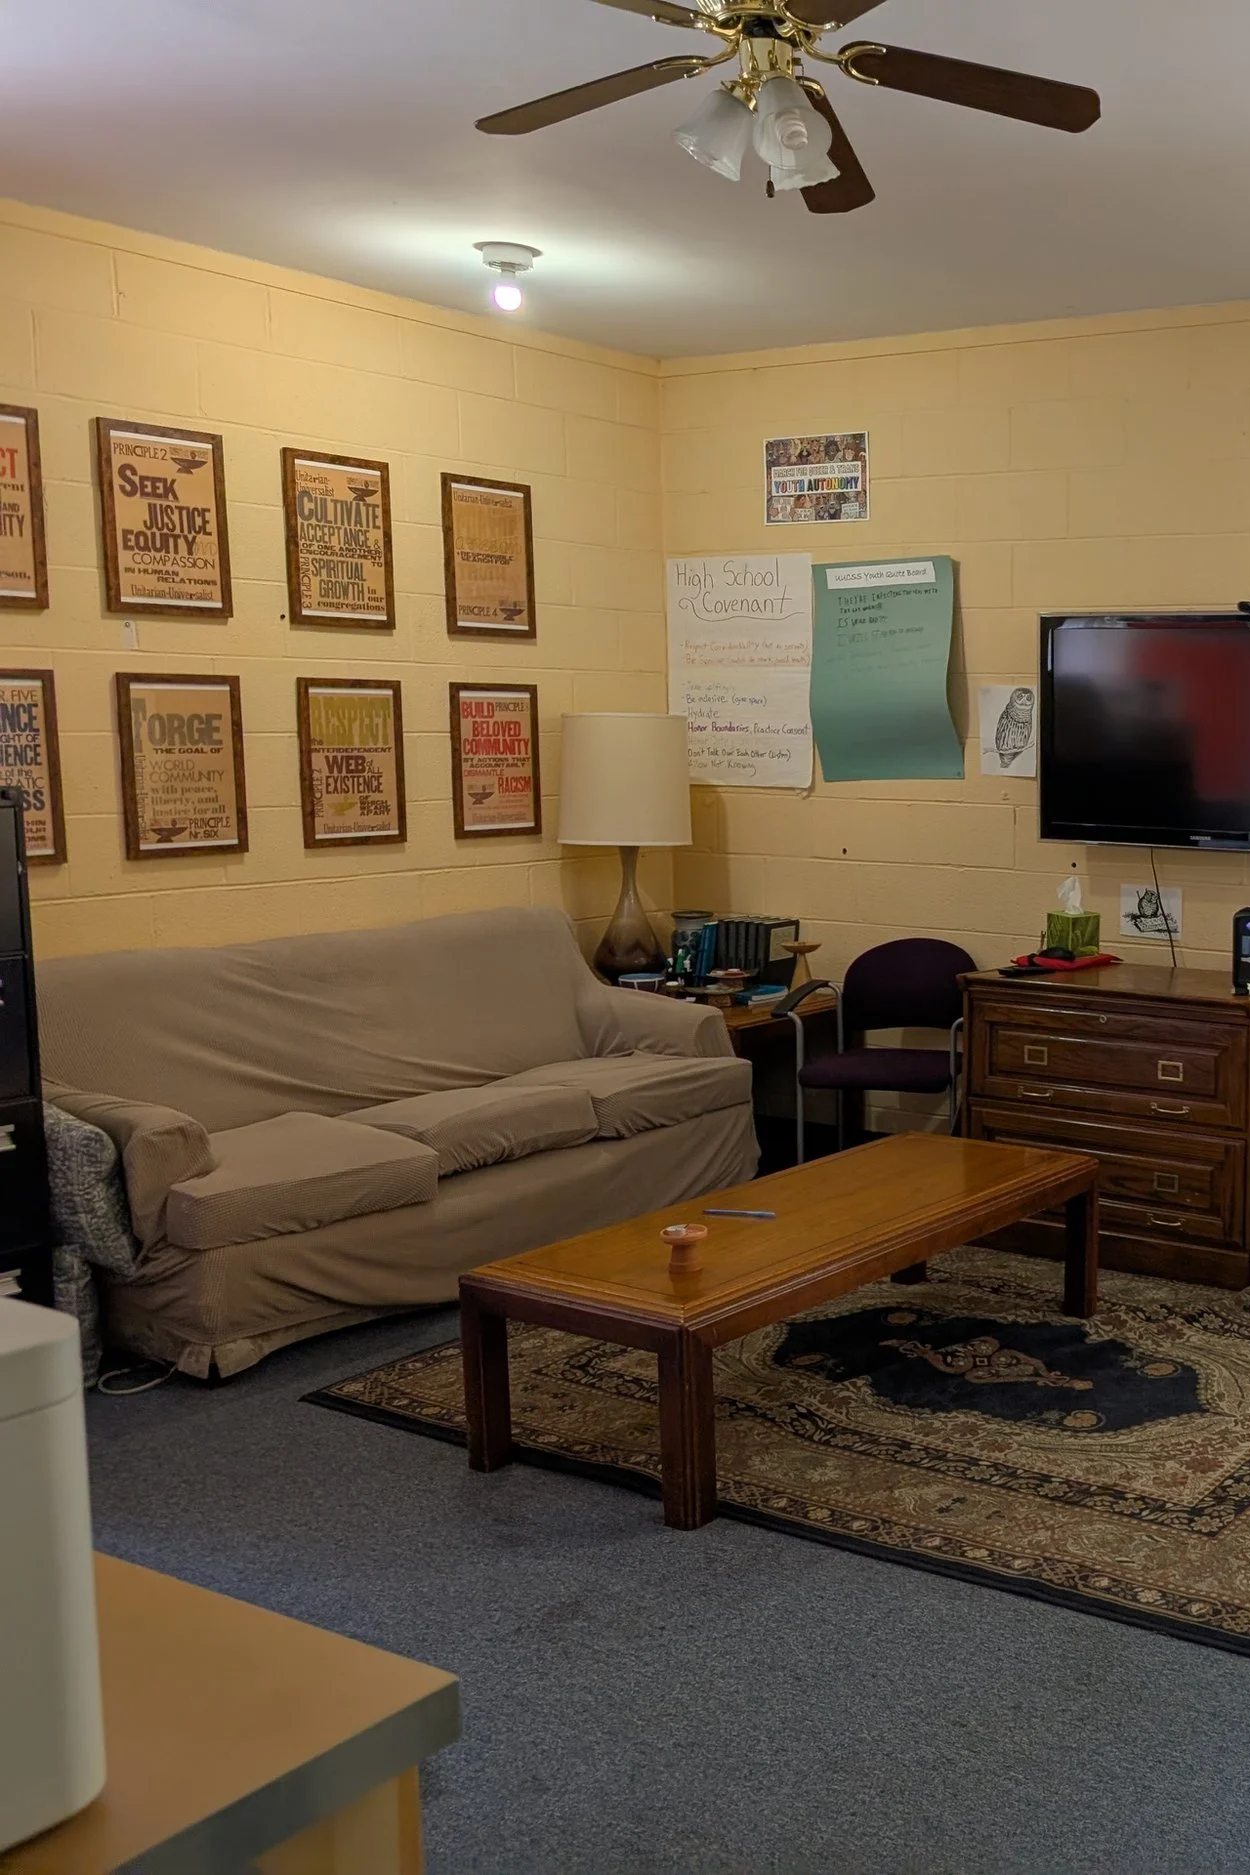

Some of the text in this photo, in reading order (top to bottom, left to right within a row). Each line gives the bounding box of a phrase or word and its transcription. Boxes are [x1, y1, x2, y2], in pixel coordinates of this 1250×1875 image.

[113, 442, 169, 461] PRINCIPLE 2
[118, 463, 179, 501] SEEK
[774, 477, 859, 493] YOUTH AUTONOMY
[297, 490, 381, 530] CULTIVATE
[143, 503, 212, 536] JUSTICE
[121, 529, 197, 556] EQUITY
[300, 522, 371, 549] ACCEPTANCE
[132, 553, 215, 570] COMPASSION
[300, 549, 383, 561] ENCOURAGEMENT
[138, 568, 179, 577] HUMAN
[311, 557, 367, 582] SPIRITUAL
[157, 576, 217, 586] RELATIONS
[300, 556, 312, 609] PRINCIPLE 3
[676, 558, 780, 599] High School
[319, 579, 365, 602] GROWTH
[318, 601, 385, 611] congregations
[702, 585, 792, 614] Covenant
[459, 605, 498, 617] PRINCIPLE 4
[11, 690, 38, 702] FIVE
[462, 701, 495, 719] BUILD
[687, 707, 720, 720] Hydrate
[472, 720, 521, 738] BELOVED
[26, 734, 41, 744] OF
[463, 738, 529, 756] COMMUNITY
[17, 768, 33, 777] the
[150, 759, 195, 771] WORLD
[324, 755, 366, 774] WEB
[367, 766, 383, 774] ALL
[150, 770, 225, 784] COMMUNITY
[325, 775, 383, 794] EXISTENCE
[498, 776, 532, 794] RACISM
[151, 784, 178, 794] with
[198, 794, 219, 804] and
[192, 804, 226, 815] for all
[188, 816, 231, 829] PRINCIPLE
[203, 829, 219, 838] SIX
